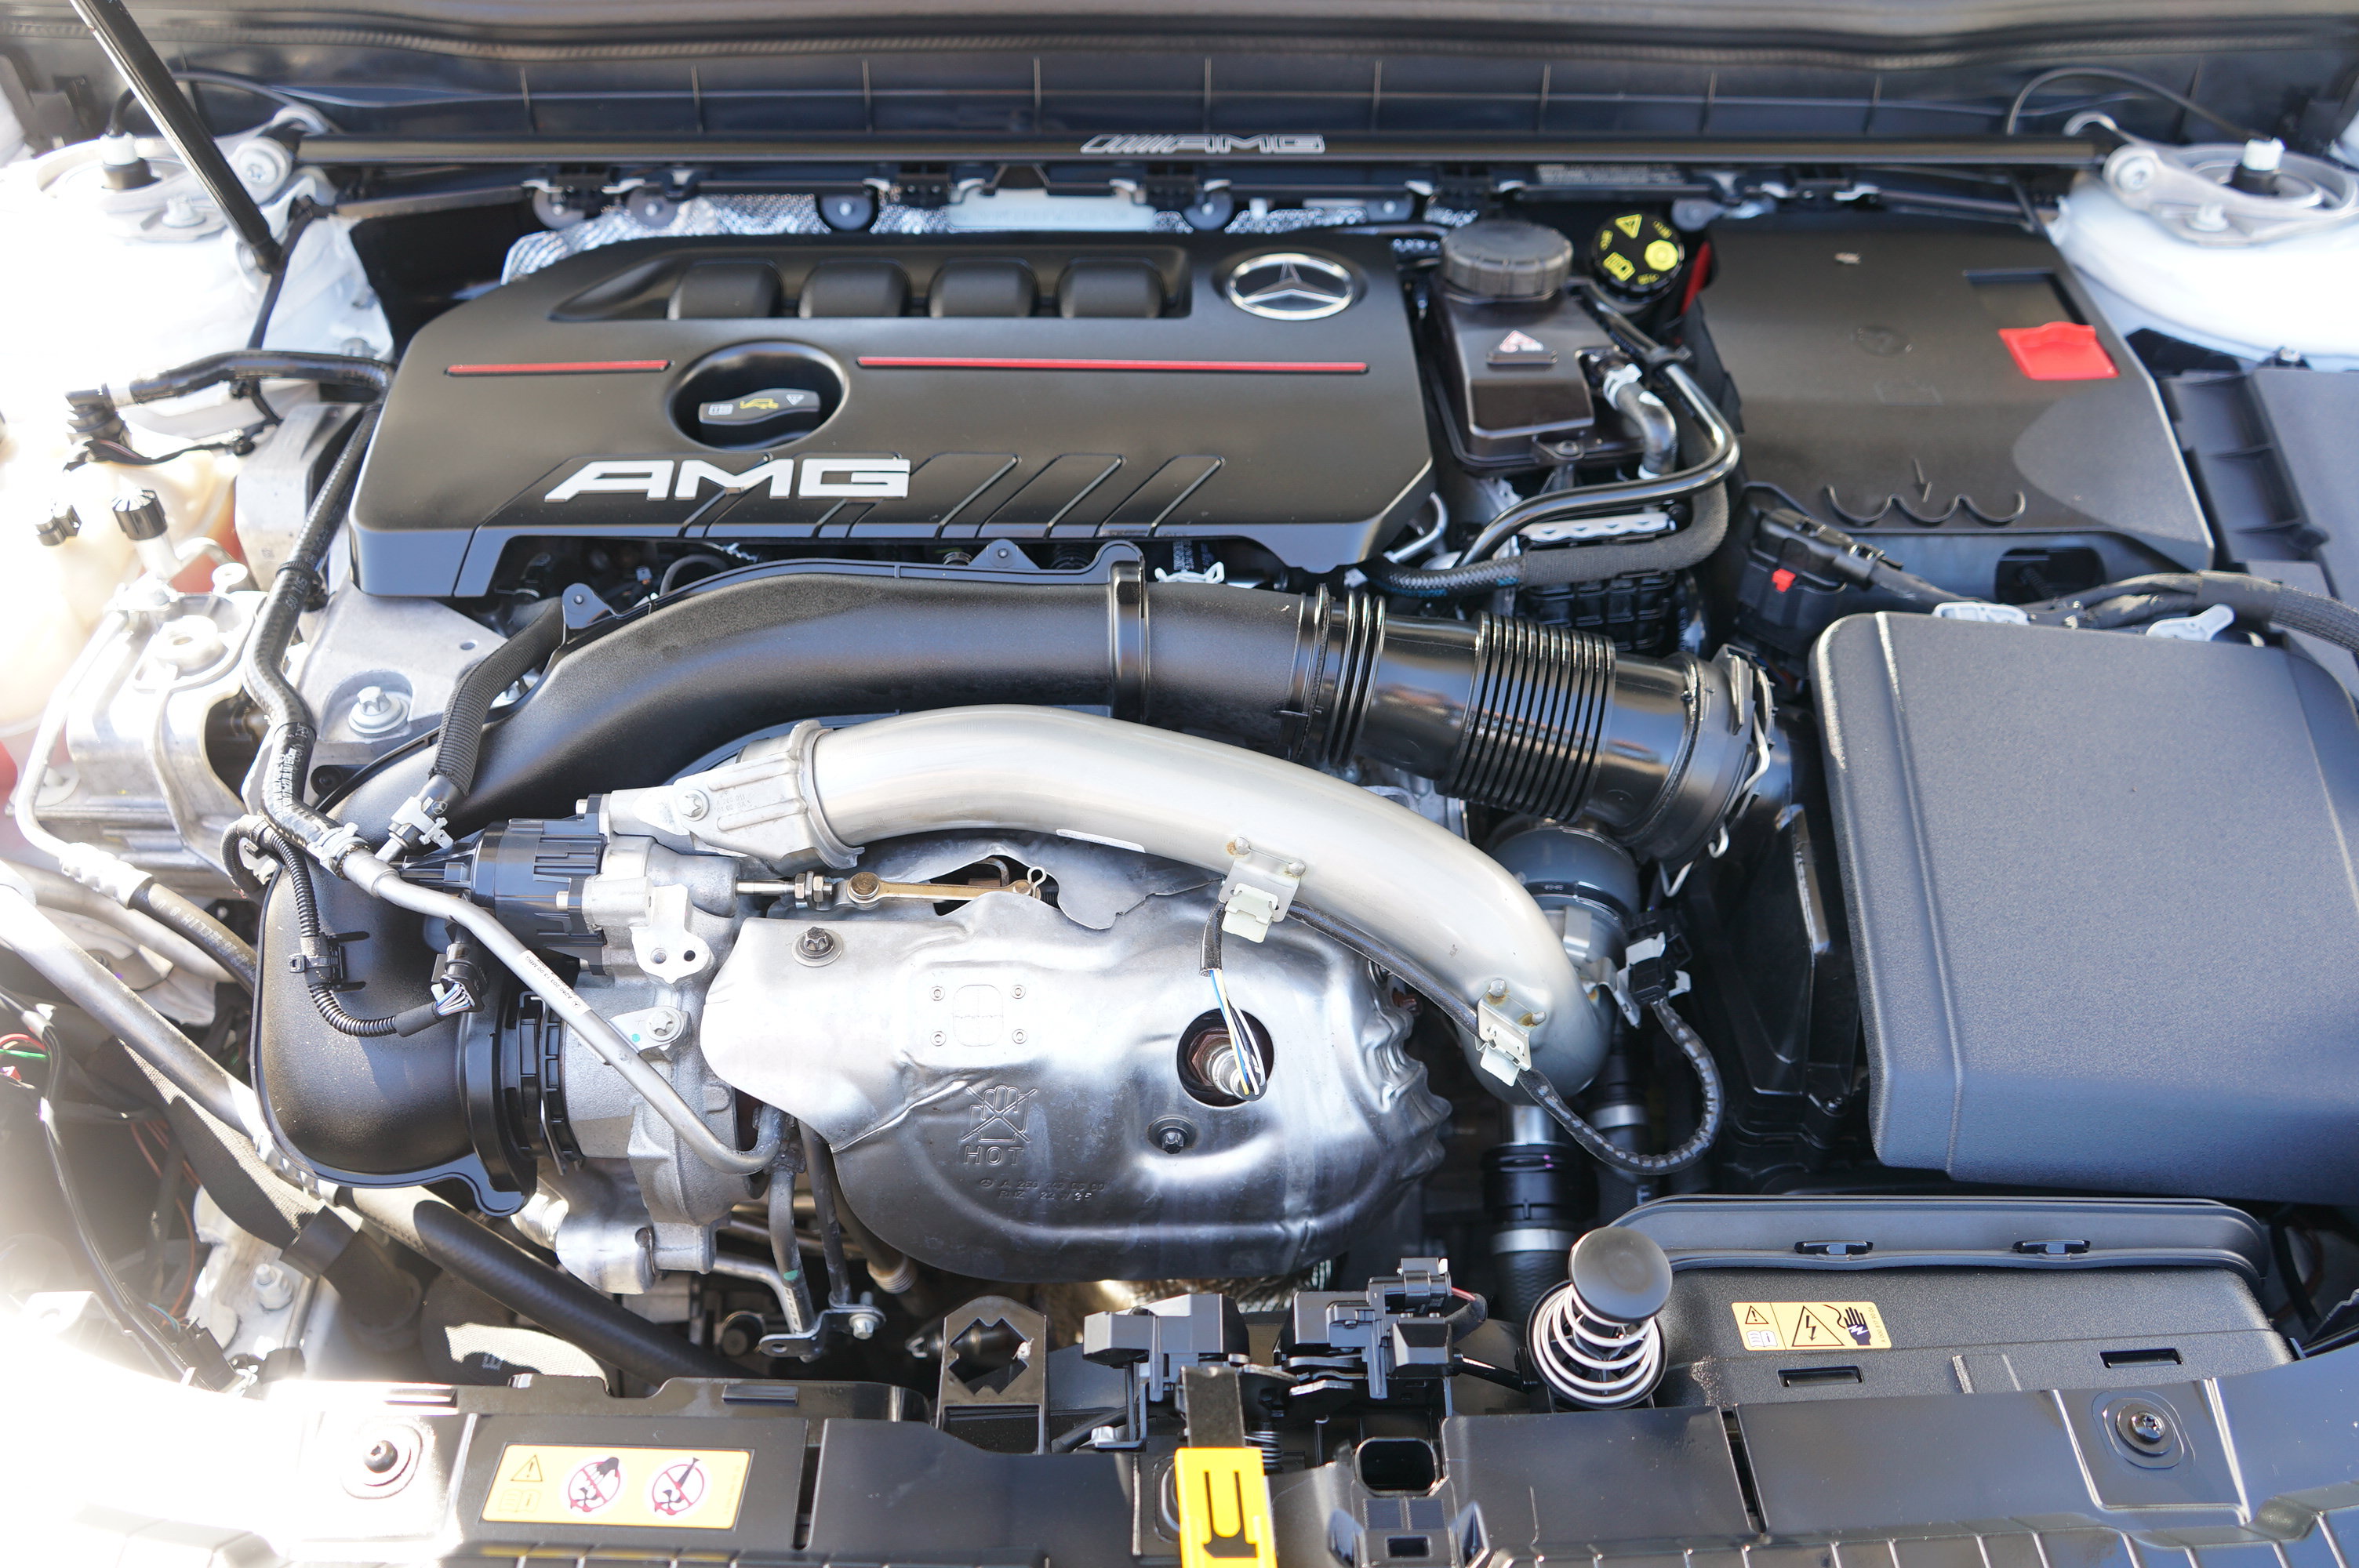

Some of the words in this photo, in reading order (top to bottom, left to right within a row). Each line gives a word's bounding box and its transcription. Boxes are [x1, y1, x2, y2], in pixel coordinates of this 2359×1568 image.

[1159, 133, 1325, 154] AMG
[544, 458, 911, 503] AMG
[962, 1145, 1024, 1167] HOT
